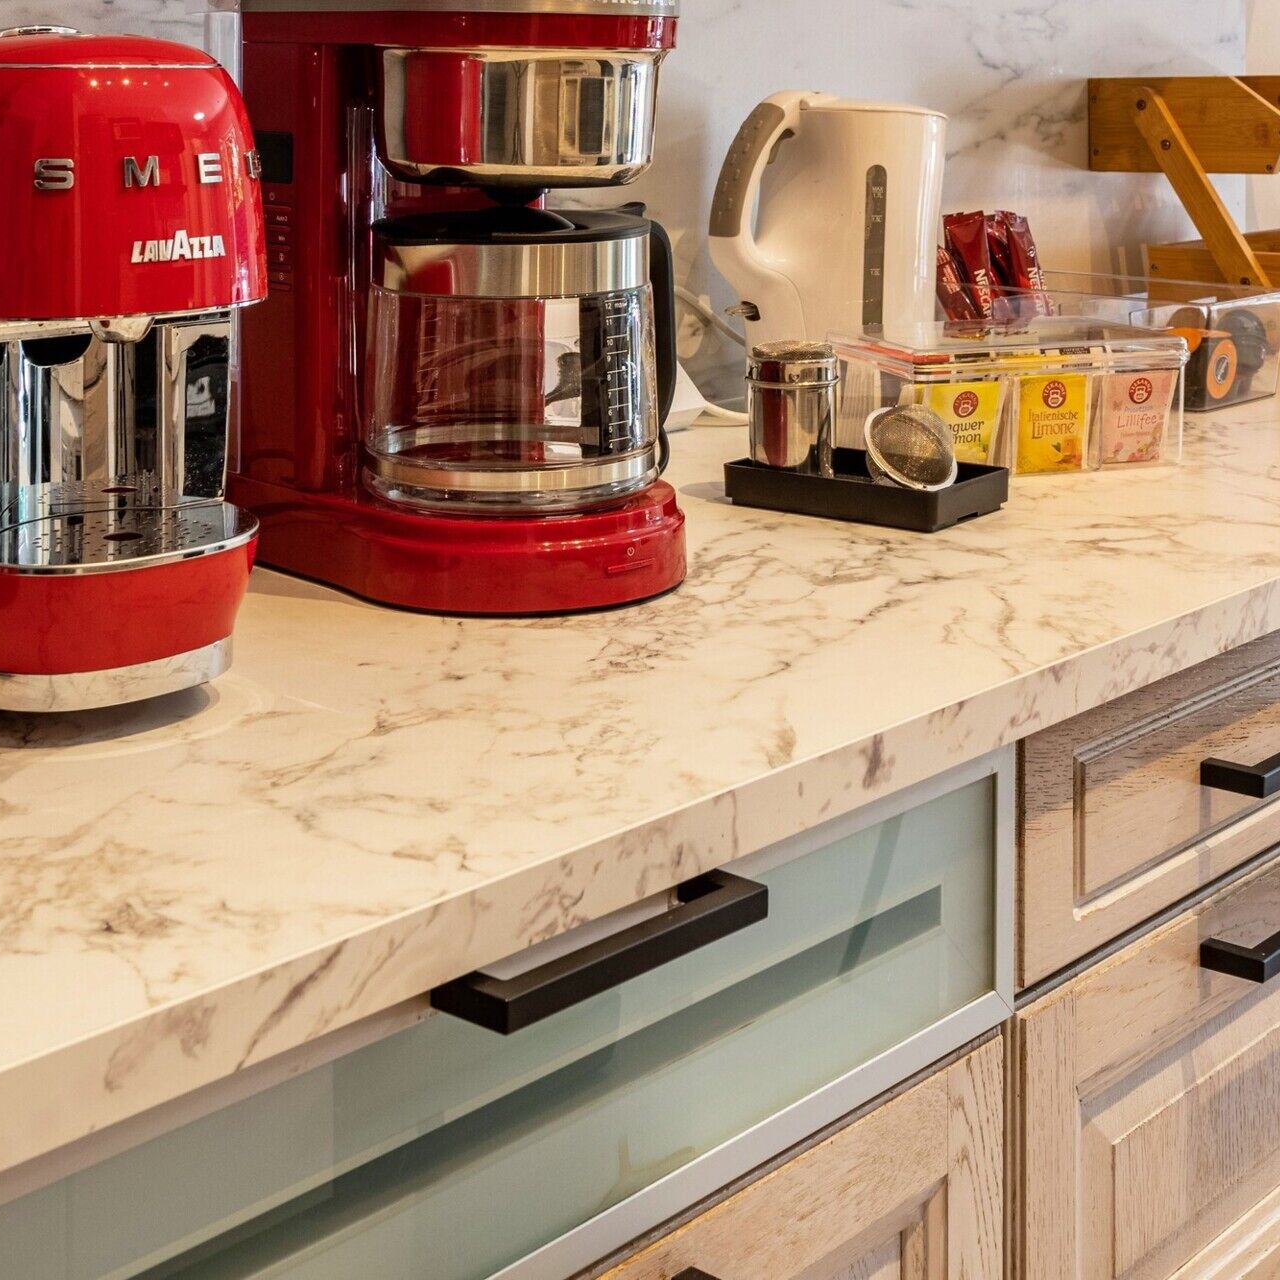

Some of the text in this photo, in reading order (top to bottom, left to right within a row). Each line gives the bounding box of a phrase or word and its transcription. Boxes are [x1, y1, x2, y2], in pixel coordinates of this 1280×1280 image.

[131, 229, 226, 264] LAVAZZA
[1028, 408, 1080, 422] Italienische
[1117, 412, 1158, 430] Lillifee
[948, 421, 985, 434] gwer
[1031, 422, 1076, 440] Limone
[953, 433, 982, 444] mon
